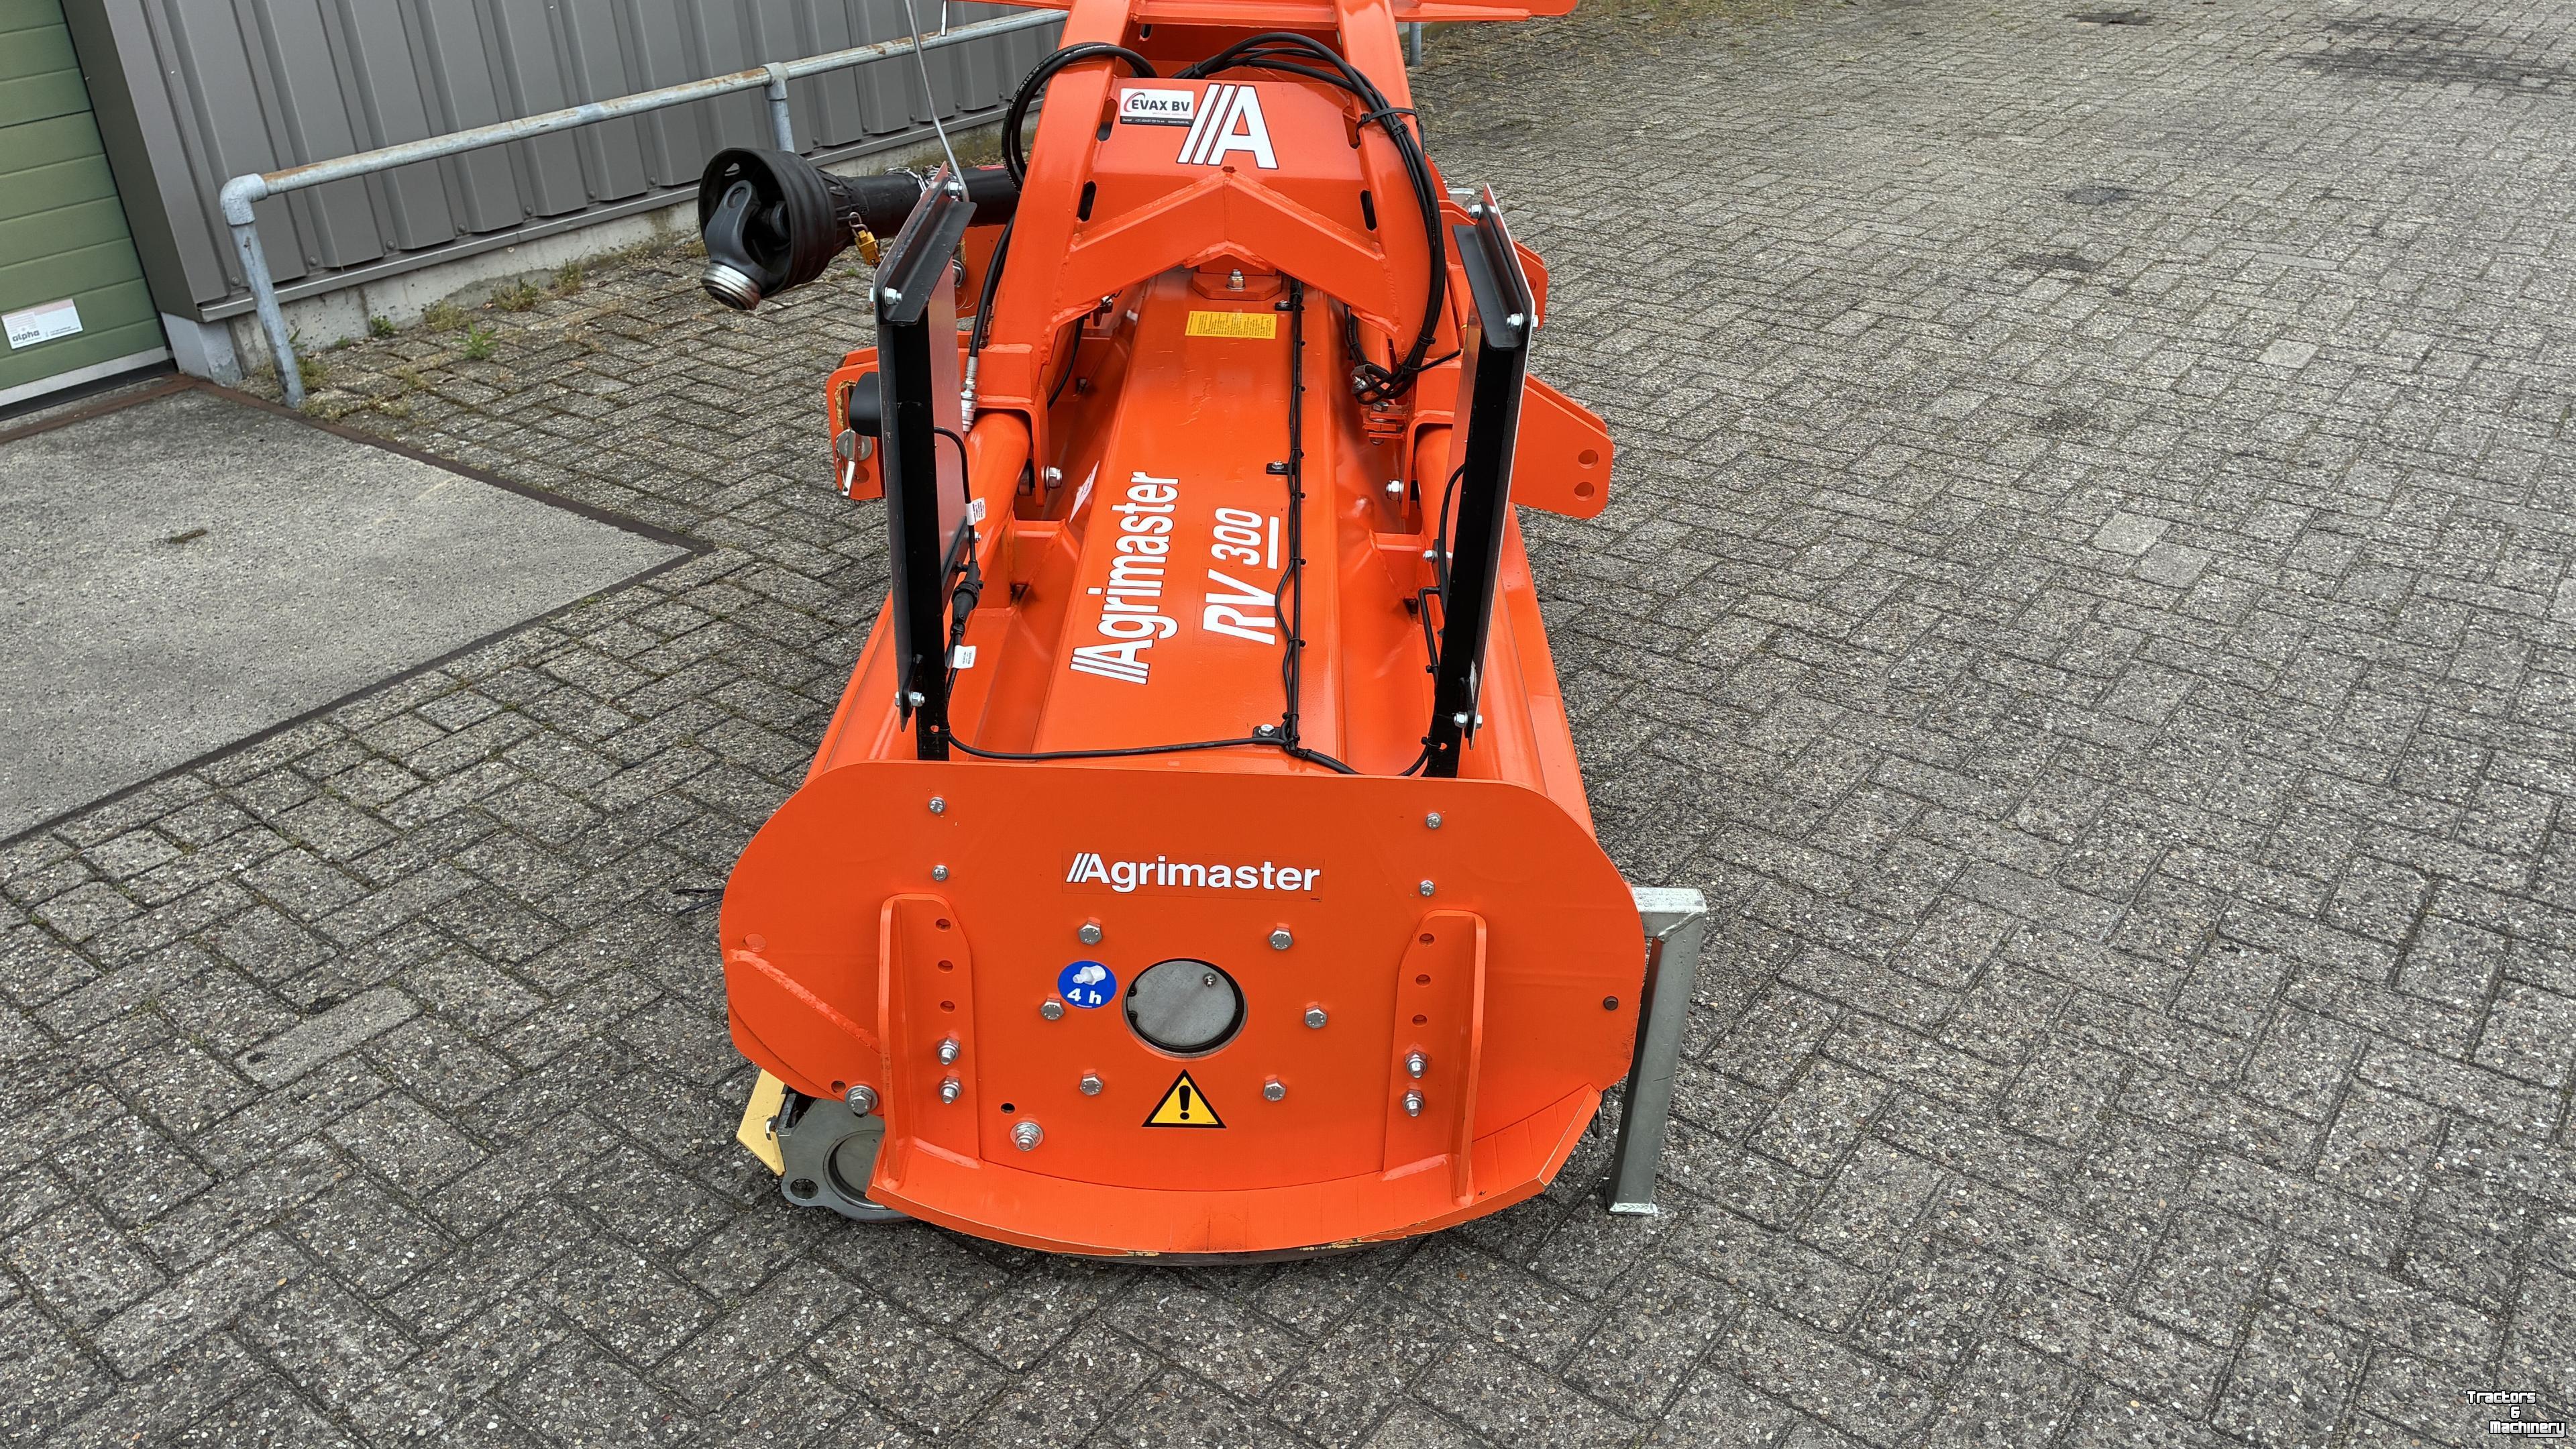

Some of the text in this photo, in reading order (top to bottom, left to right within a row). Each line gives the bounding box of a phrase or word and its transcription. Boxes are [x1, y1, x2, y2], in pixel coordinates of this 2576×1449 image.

[1132, 99, 1190, 111] EVAX BV
[12, 330, 40, 342] alpha
[1201, 506, 1277, 646] RV 300
[1080, 853, 1321, 893] Agrimaster
[1067, 987, 1102, 1005] 4 h
